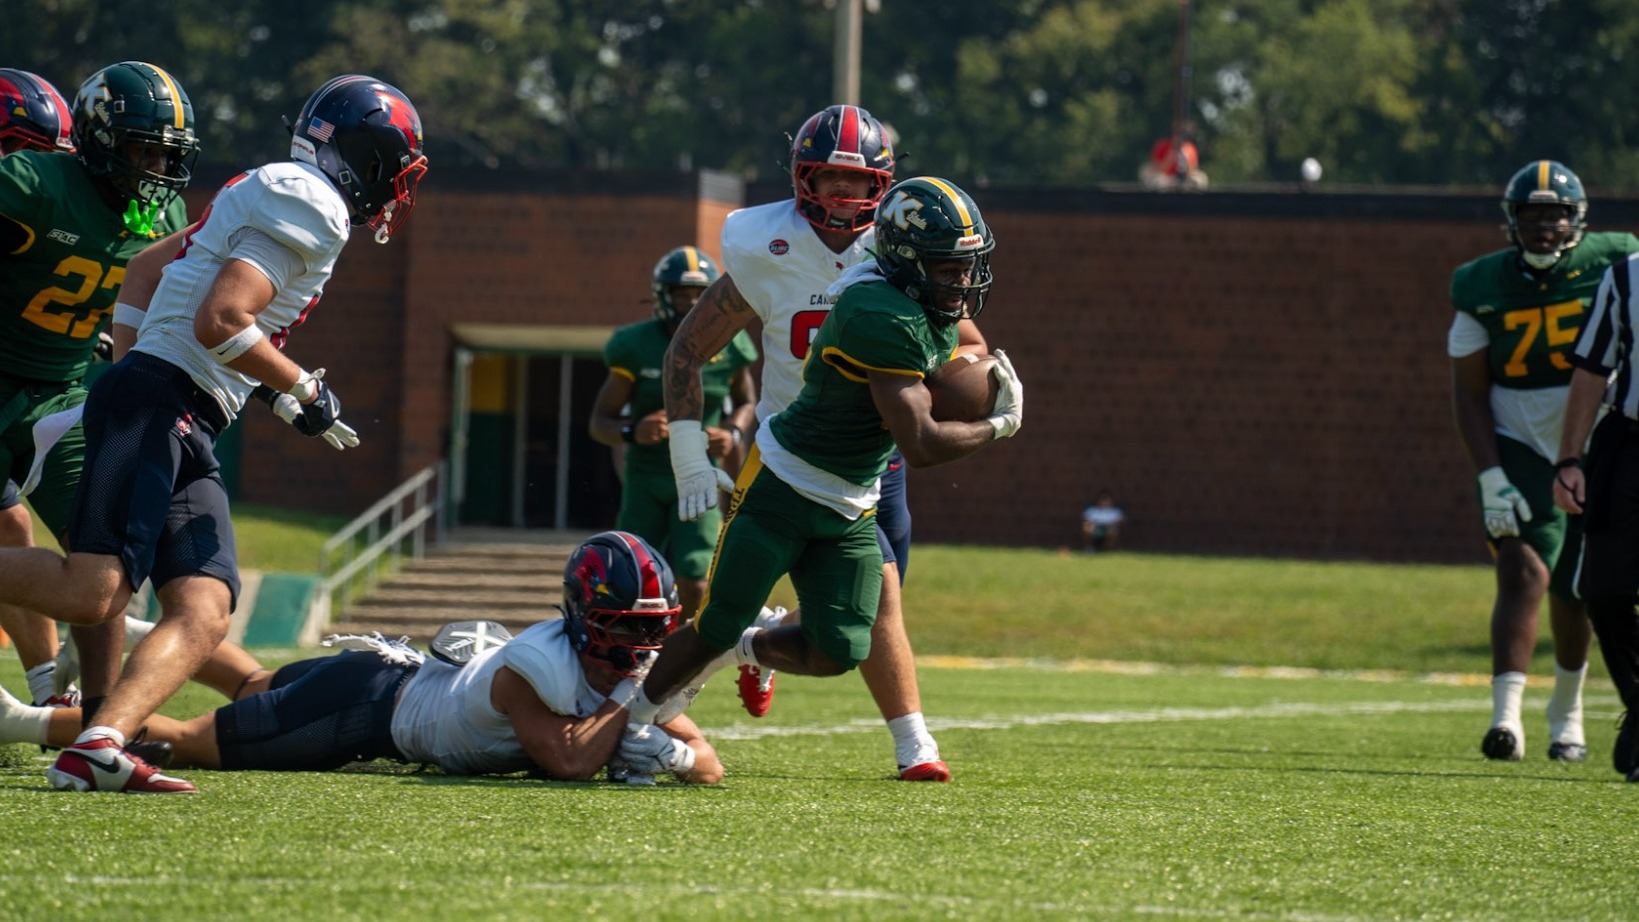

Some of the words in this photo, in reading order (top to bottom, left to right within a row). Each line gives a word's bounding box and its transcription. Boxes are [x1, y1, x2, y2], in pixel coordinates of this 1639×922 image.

[960, 236, 981, 247] Riddell
[21, 255, 127, 338] 27
[1504, 300, 1584, 377] 75
